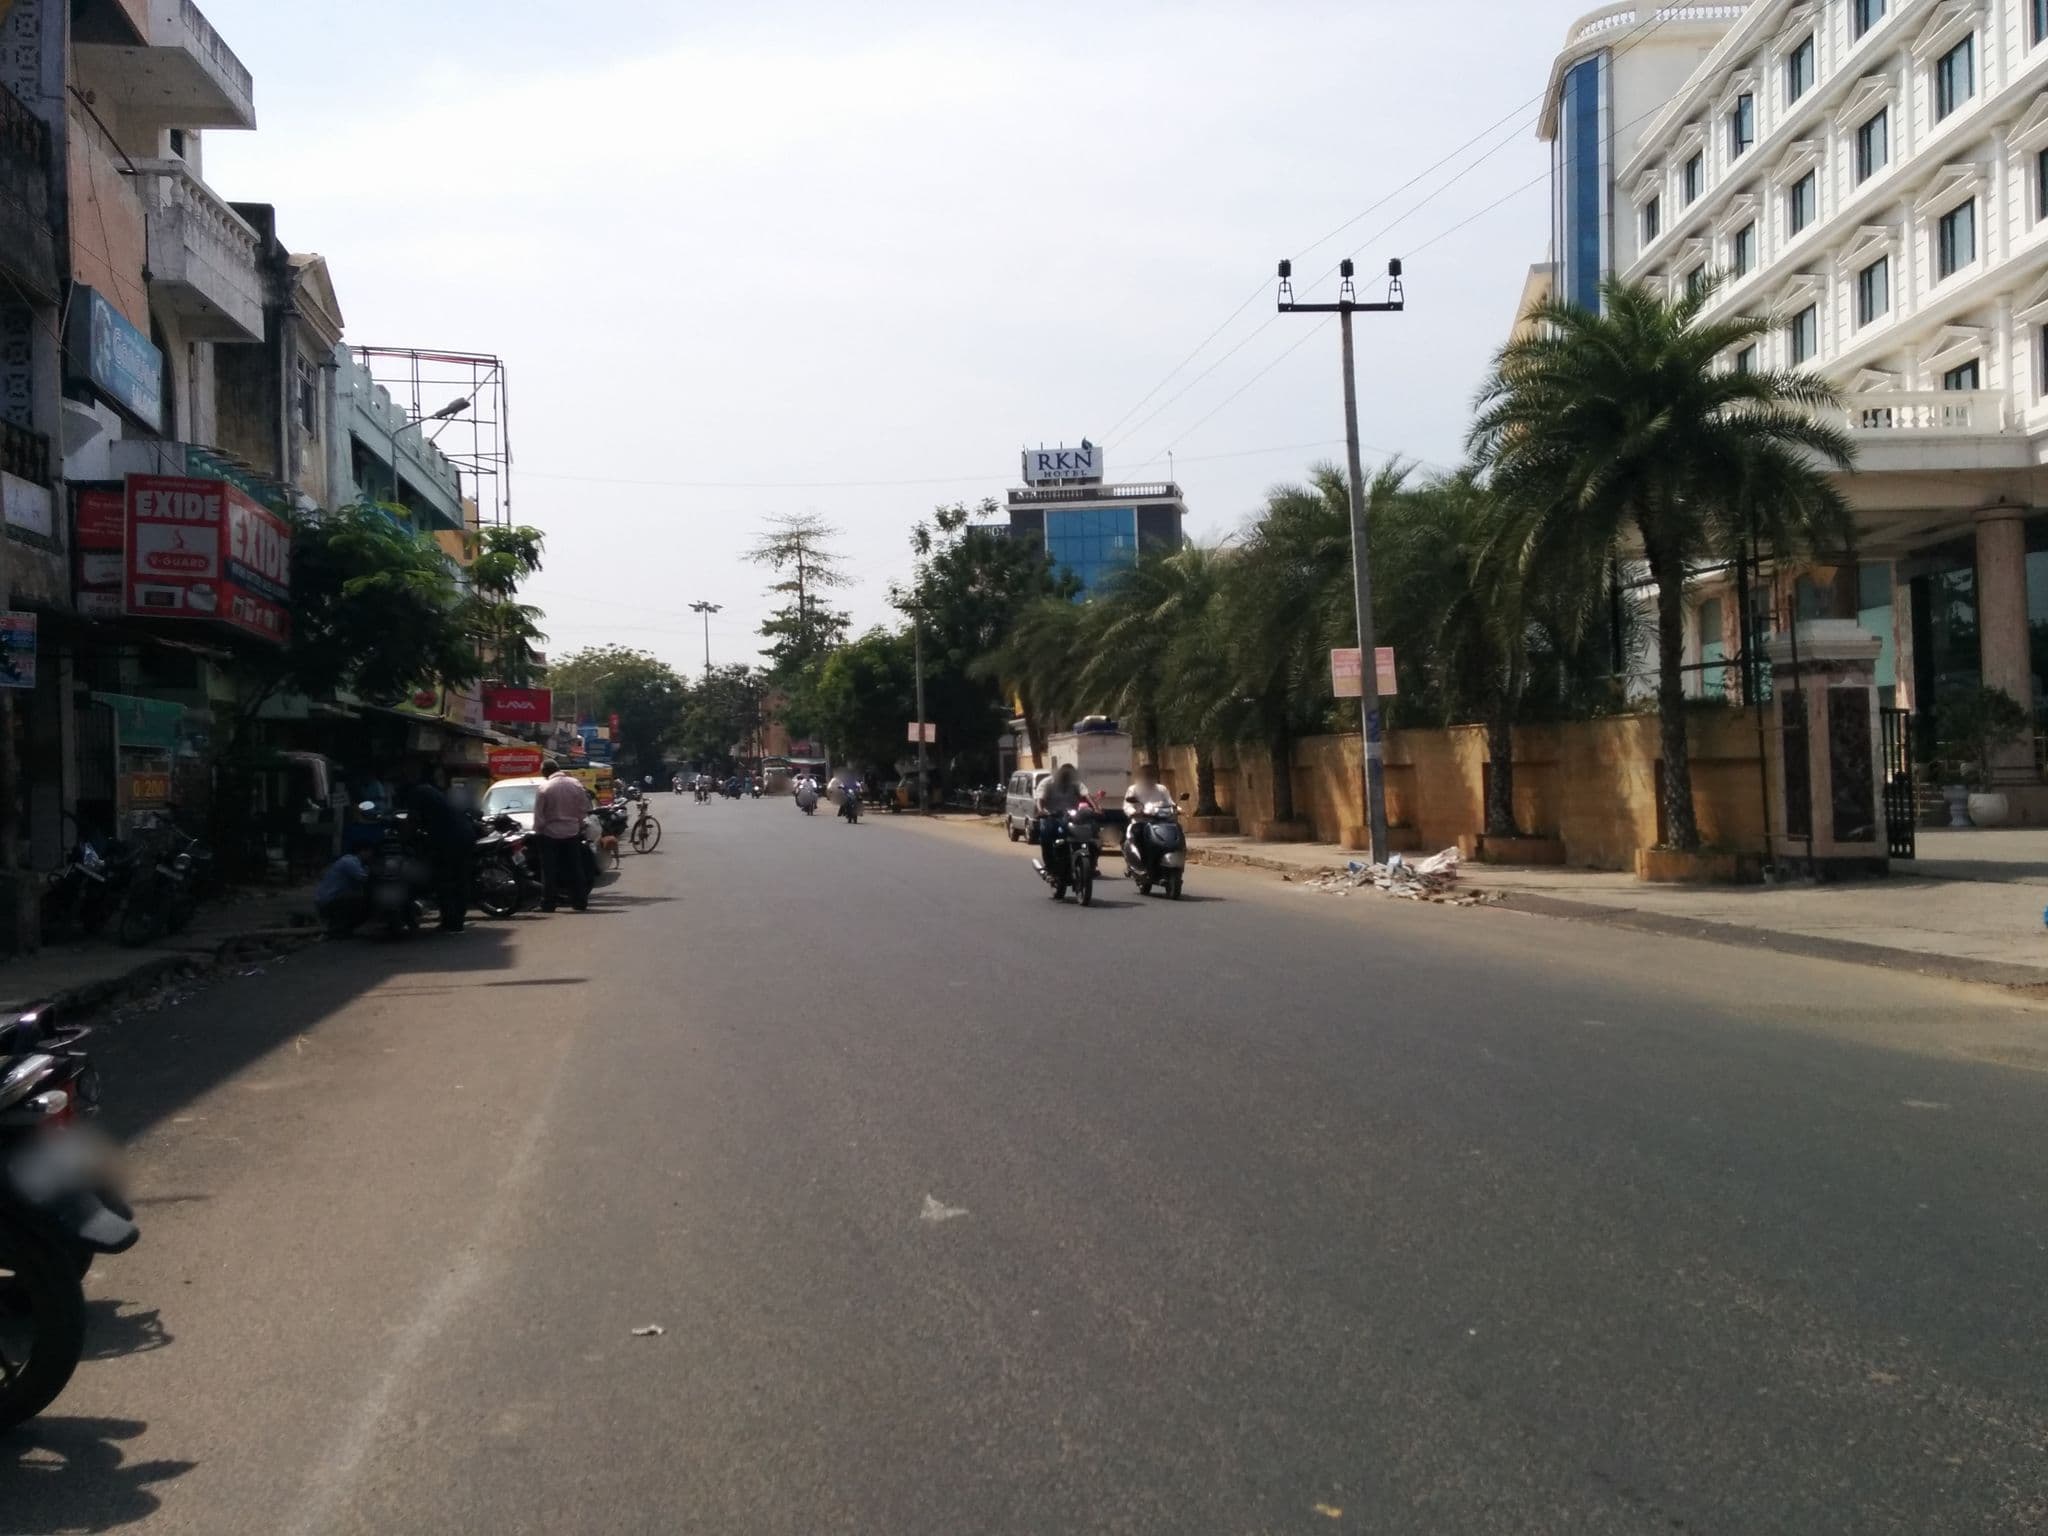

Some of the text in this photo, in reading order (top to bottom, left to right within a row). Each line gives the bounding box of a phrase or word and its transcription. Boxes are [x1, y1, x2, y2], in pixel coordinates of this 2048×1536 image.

[1038, 451, 1092, 470] RKN
[135, 490, 221, 521] EXIDE
[229, 501, 290, 585] EXIDE
[149, 555, 207, 569] V-GUARD
[497, 700, 536, 711] LAVA
